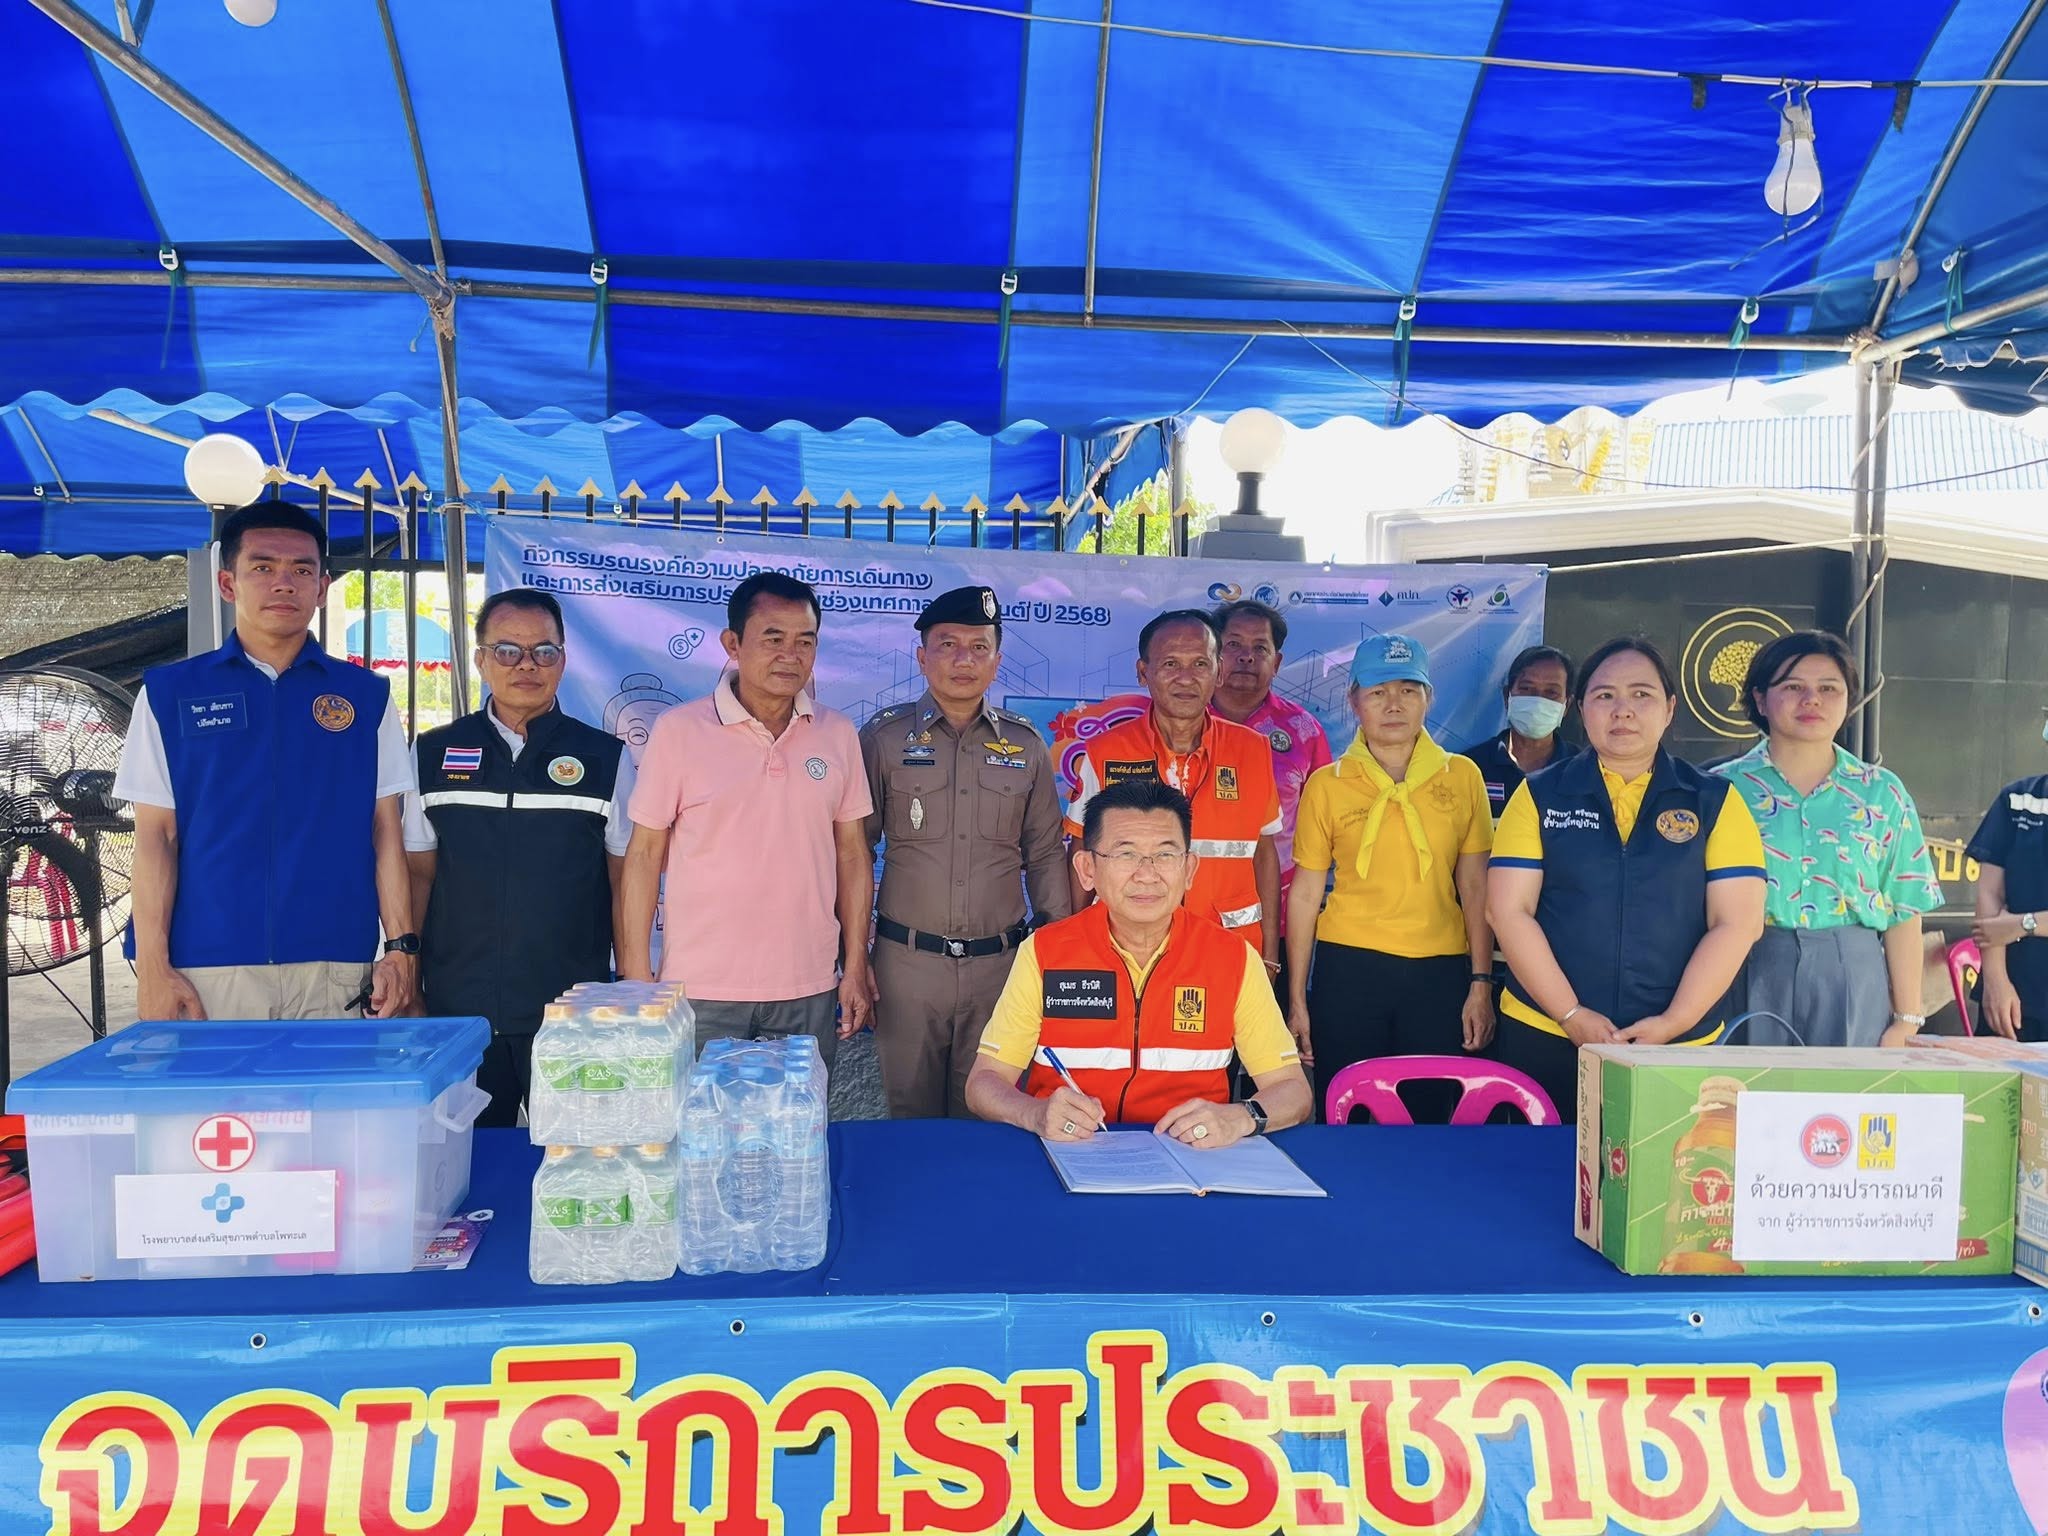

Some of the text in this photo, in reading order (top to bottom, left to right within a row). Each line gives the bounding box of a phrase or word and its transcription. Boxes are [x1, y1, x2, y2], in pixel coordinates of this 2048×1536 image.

[1034, 603, 1050, 621] ปี
[1056, 604, 1108, 623] 2568
[1750, 1173, 1943, 1200] ด้วยความปรารถนาดี
[1758, 1212, 1934, 1233] จาก ผู้ว่าราชการจังหวัดสิงห์บุรี
[40, 1332, 1858, 1536] จดบริการประชาชน
